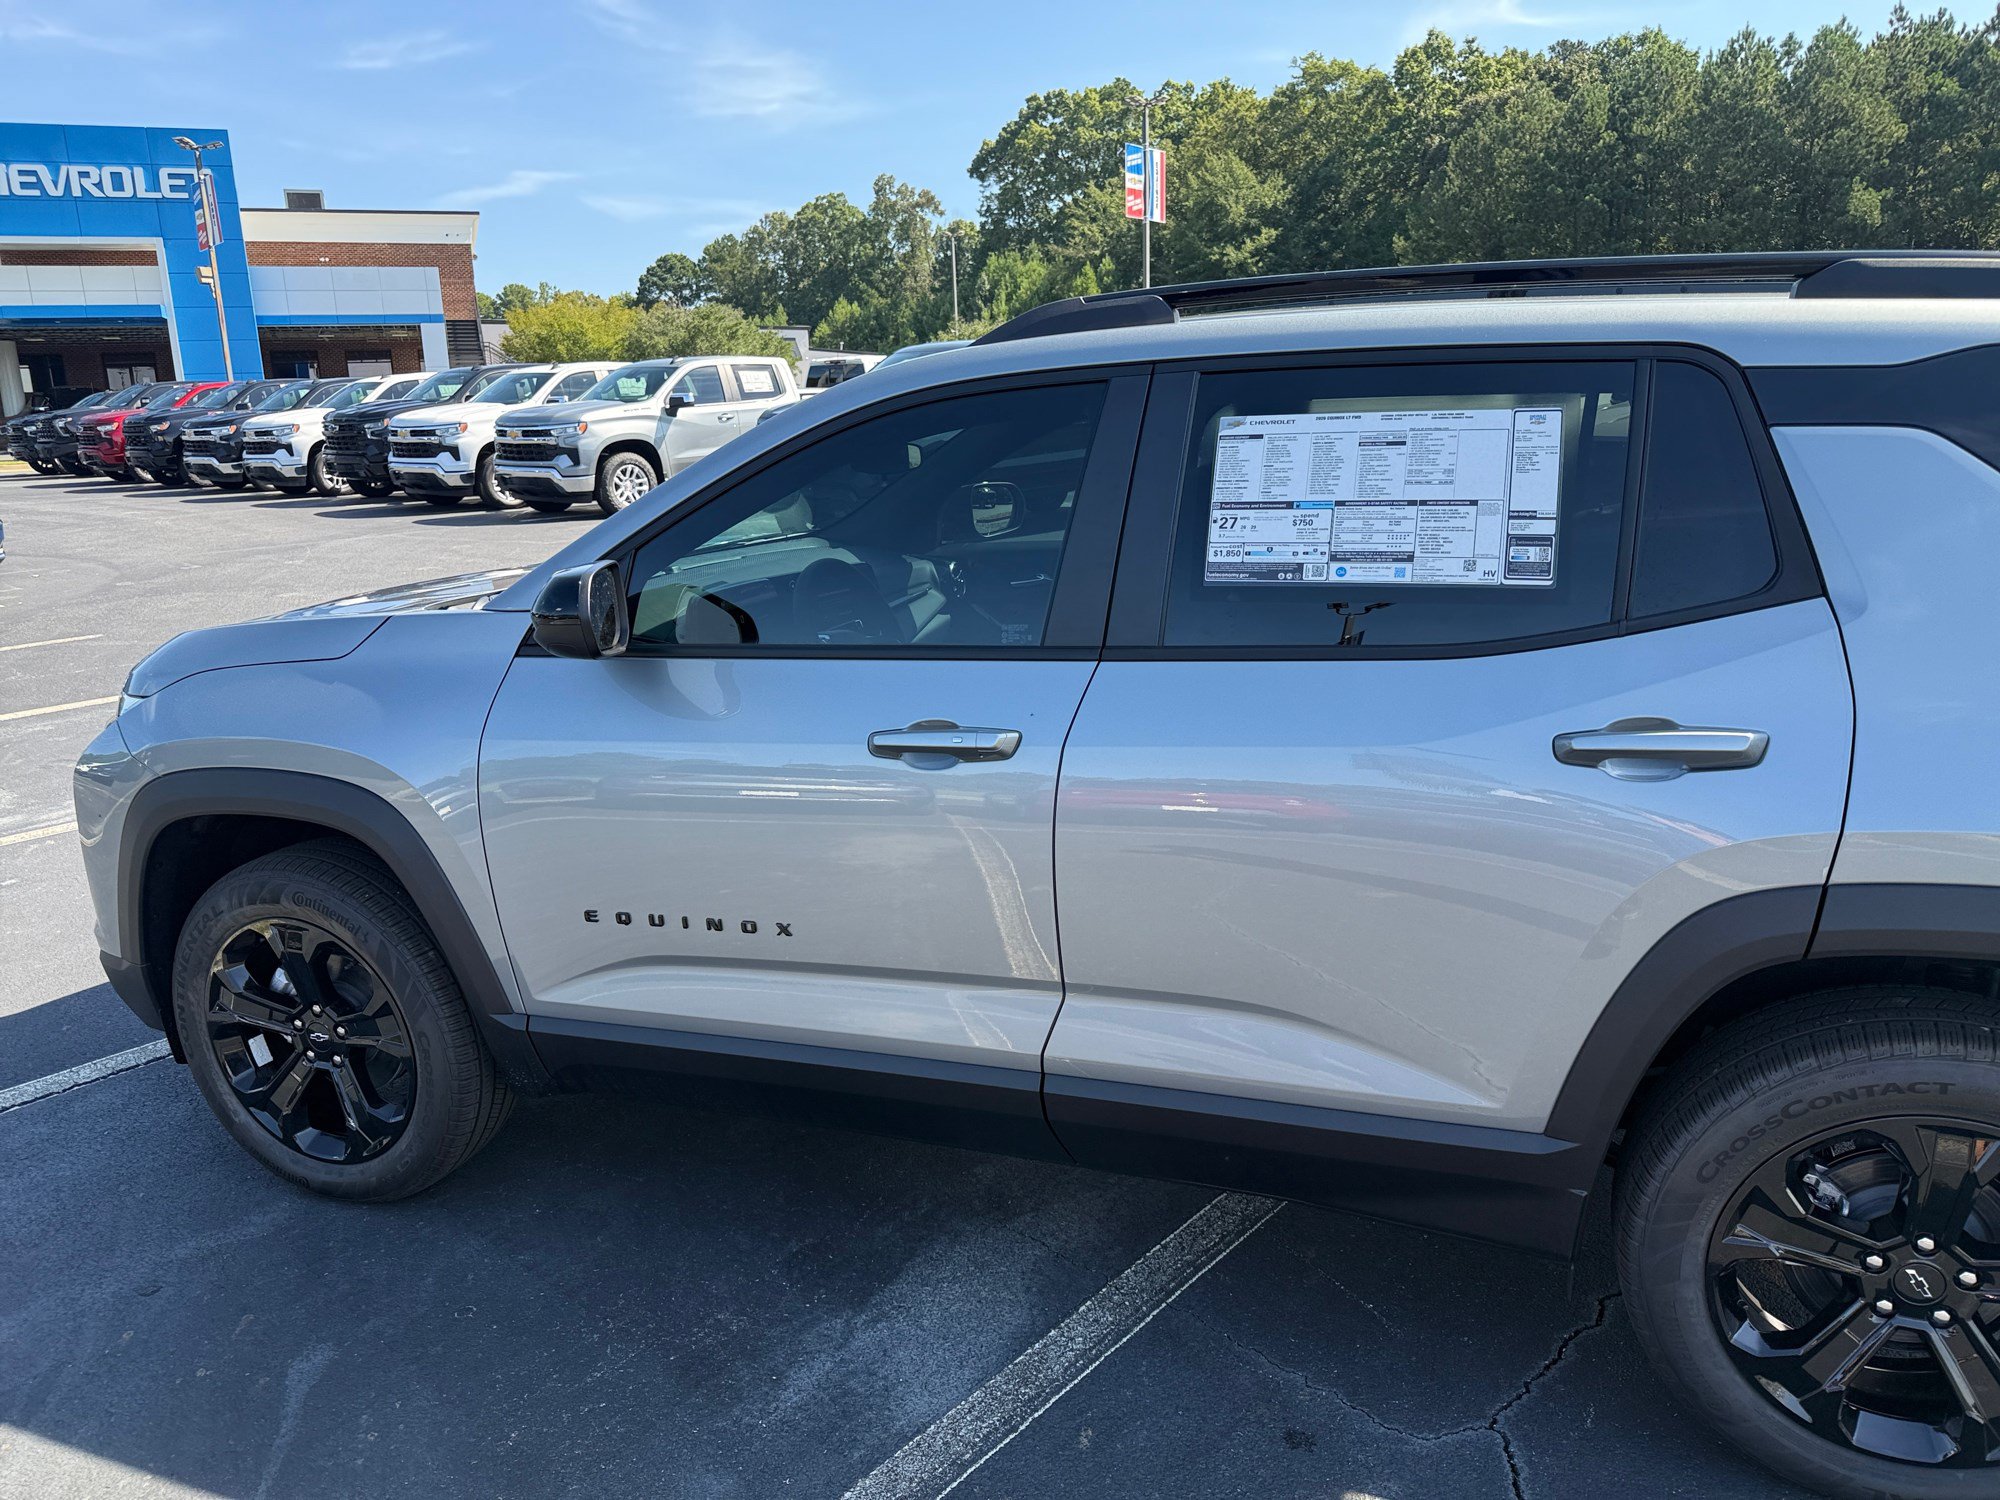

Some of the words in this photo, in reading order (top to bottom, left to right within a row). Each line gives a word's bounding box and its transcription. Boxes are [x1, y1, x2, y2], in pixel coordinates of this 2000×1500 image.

[1218, 516, 1238, 530] 27
[1292, 518, 1314, 527] $750
[1213, 549, 1241, 557] $1,850
[1207, 571, 1250, 579] fueleconomy.gov
[1483, 569, 1497, 577] HV
[291, 891, 362, 937] Continental
[584, 909, 793, 937] EQUINOX
[1696, 1081, 1956, 1184] CROSSCONTACT
